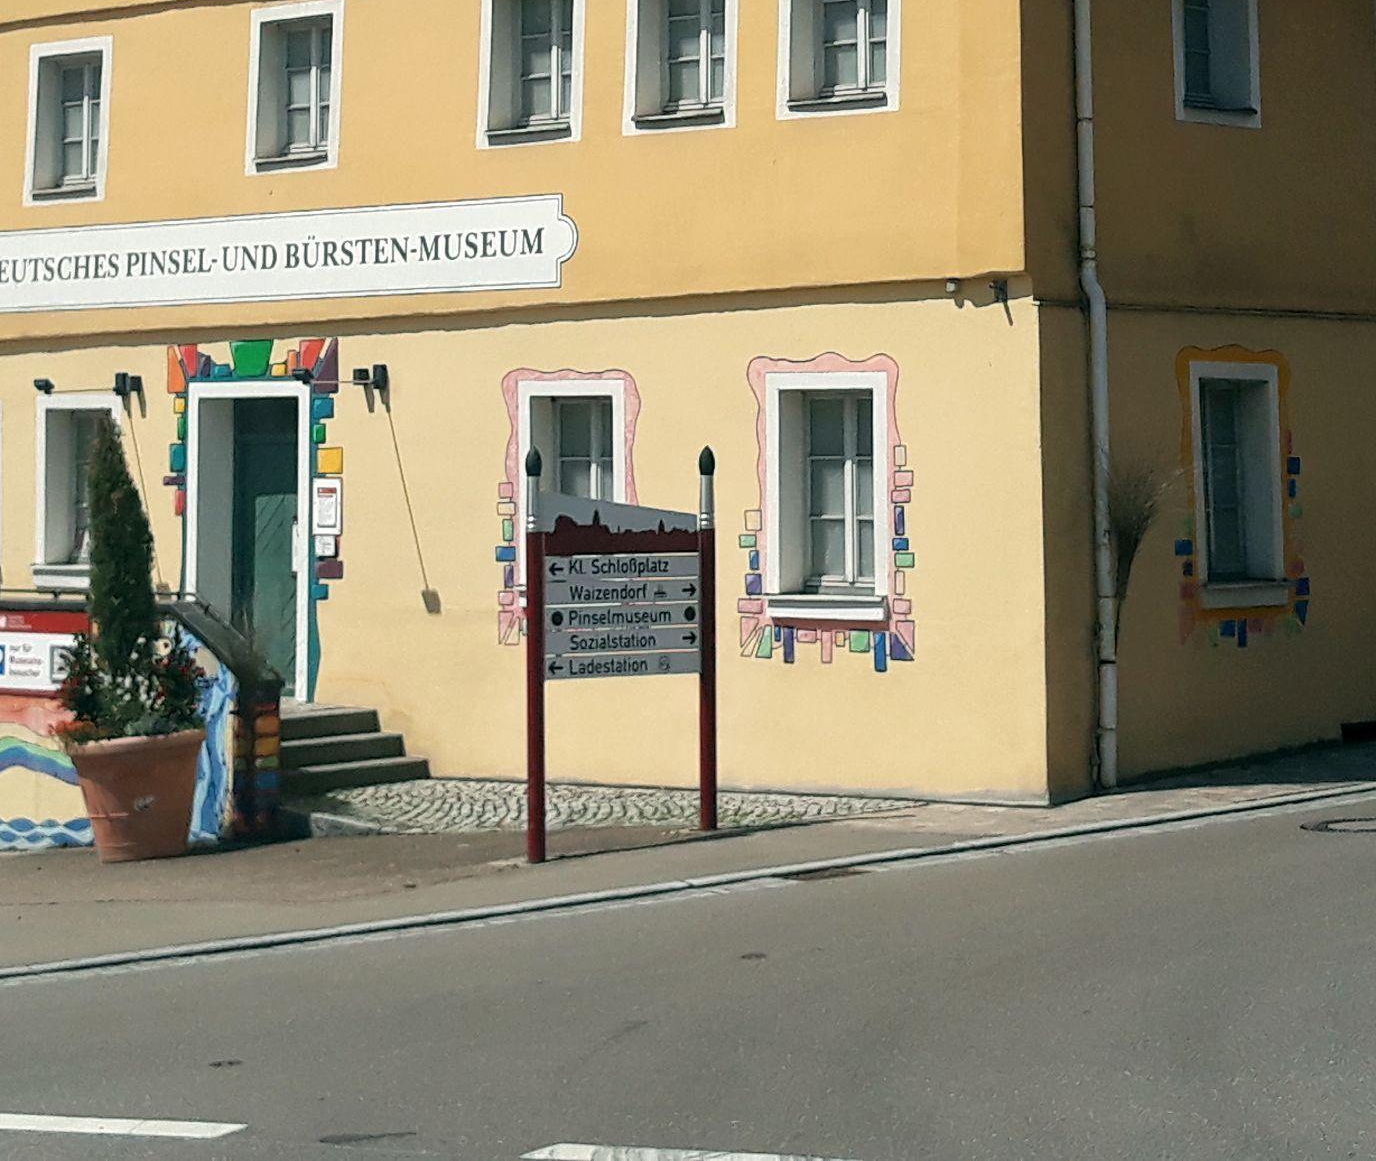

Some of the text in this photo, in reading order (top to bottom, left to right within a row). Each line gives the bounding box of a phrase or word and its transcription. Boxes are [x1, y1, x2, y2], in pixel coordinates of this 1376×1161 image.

[284, 227, 545, 270] BÜRSTEN-MUSEUM
[591, 557, 669, 577] Schloßplatz
[569, 584, 648, 601] Waizendorf
[568, 608, 672, 626] Pinselmuseum
[569, 633, 657, 651] Sozialstation
[568, 657, 649, 675] Ladestation
